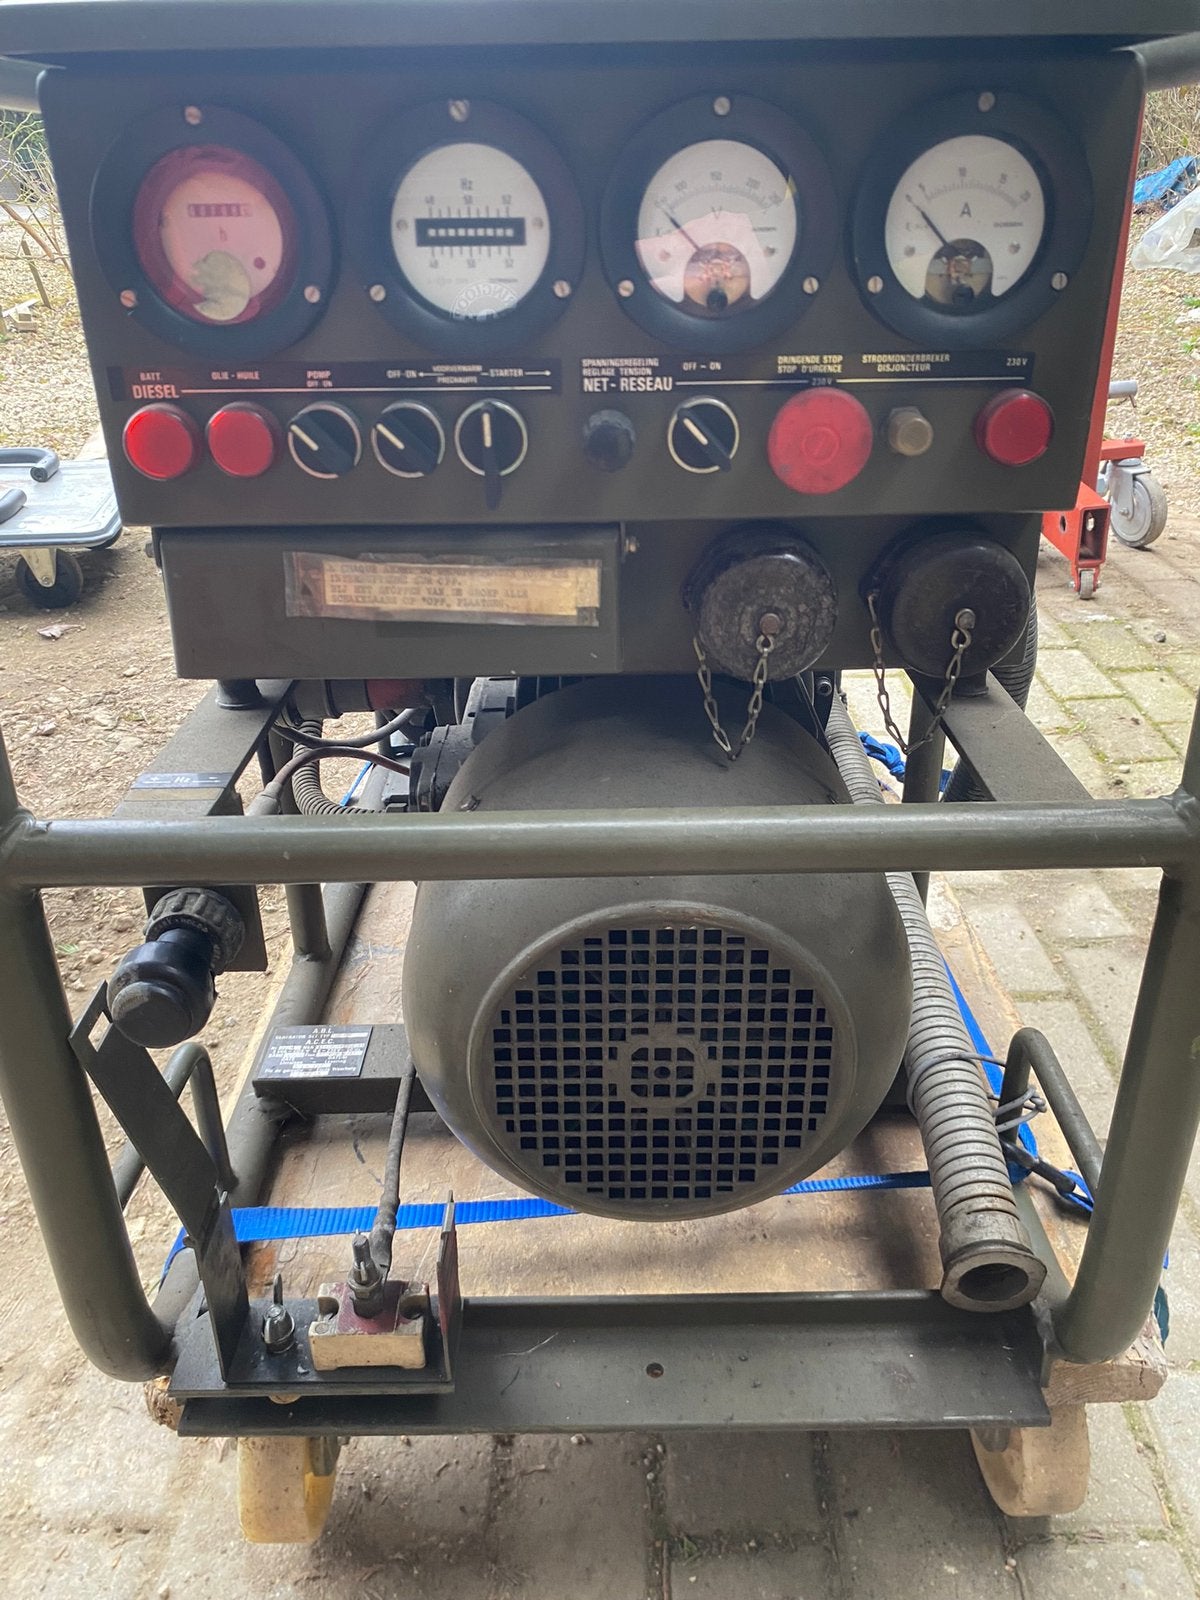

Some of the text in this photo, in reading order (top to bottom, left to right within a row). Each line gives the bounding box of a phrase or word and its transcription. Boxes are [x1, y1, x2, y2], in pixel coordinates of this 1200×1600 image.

[711, 206, 723, 220] V
[960, 202, 972, 218] A
[822, 355, 843, 363] STOP
[682, 362, 697, 371] OFF
[709, 362, 721, 370] ON
[778, 365, 797, 373] STOP
[877, 364, 931, 372] DISJONCTEUR
[307, 371, 331, 379] POMP
[489, 369, 523, 377] STARTER
[619, 367, 652, 375] TENSION
[584, 378, 609, 392] NET
[620, 377, 673, 391] RESEAU
[132, 384, 180, 399] DIESEL
